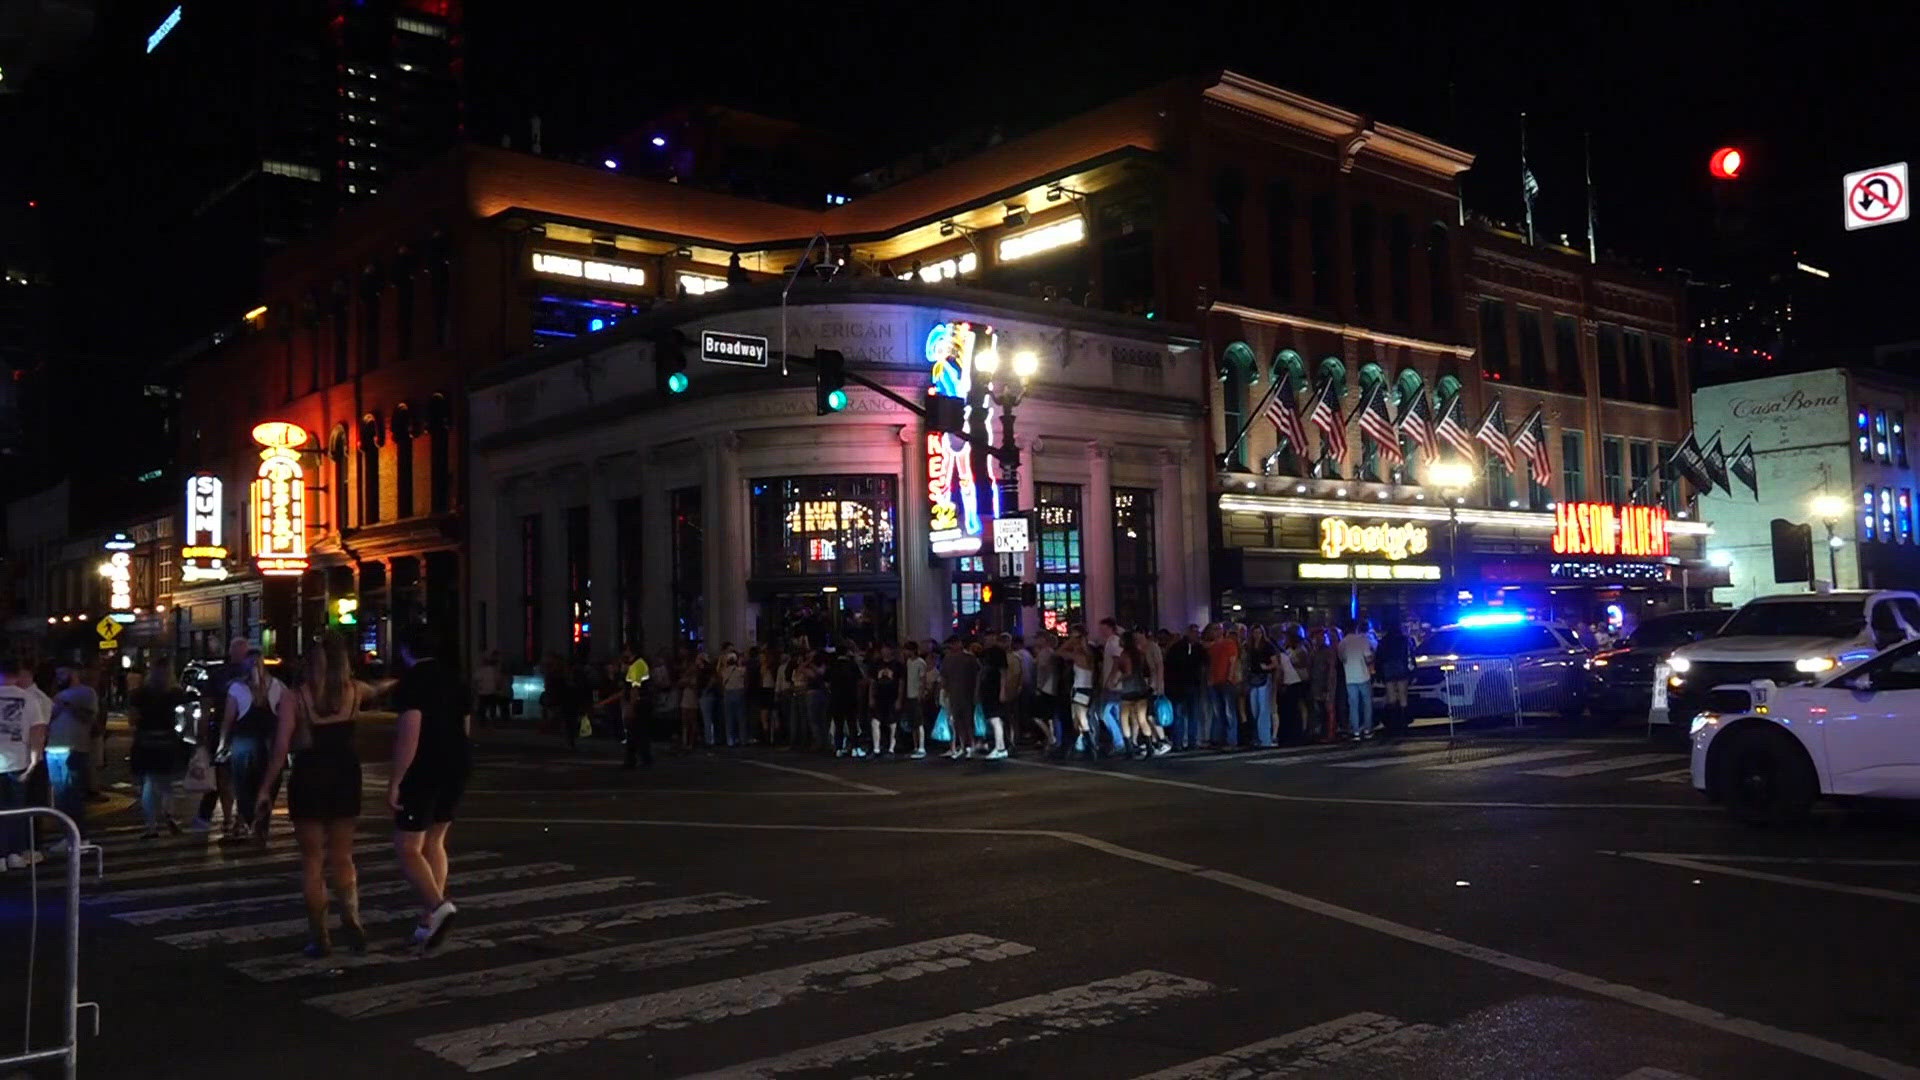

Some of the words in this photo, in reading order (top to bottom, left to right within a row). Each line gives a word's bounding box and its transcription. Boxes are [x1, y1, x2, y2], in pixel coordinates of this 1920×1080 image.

[706, 337, 763, 360] Broadway
[1728, 397, 1781, 418] Casa
[1783, 389, 1840, 411] Bona
[195, 476, 214, 531] SUN
[1321, 516, 1428, 560] Posty's
[1553, 502, 1616, 555] JASON
[1550, 563, 1606, 578] KITCHEN
